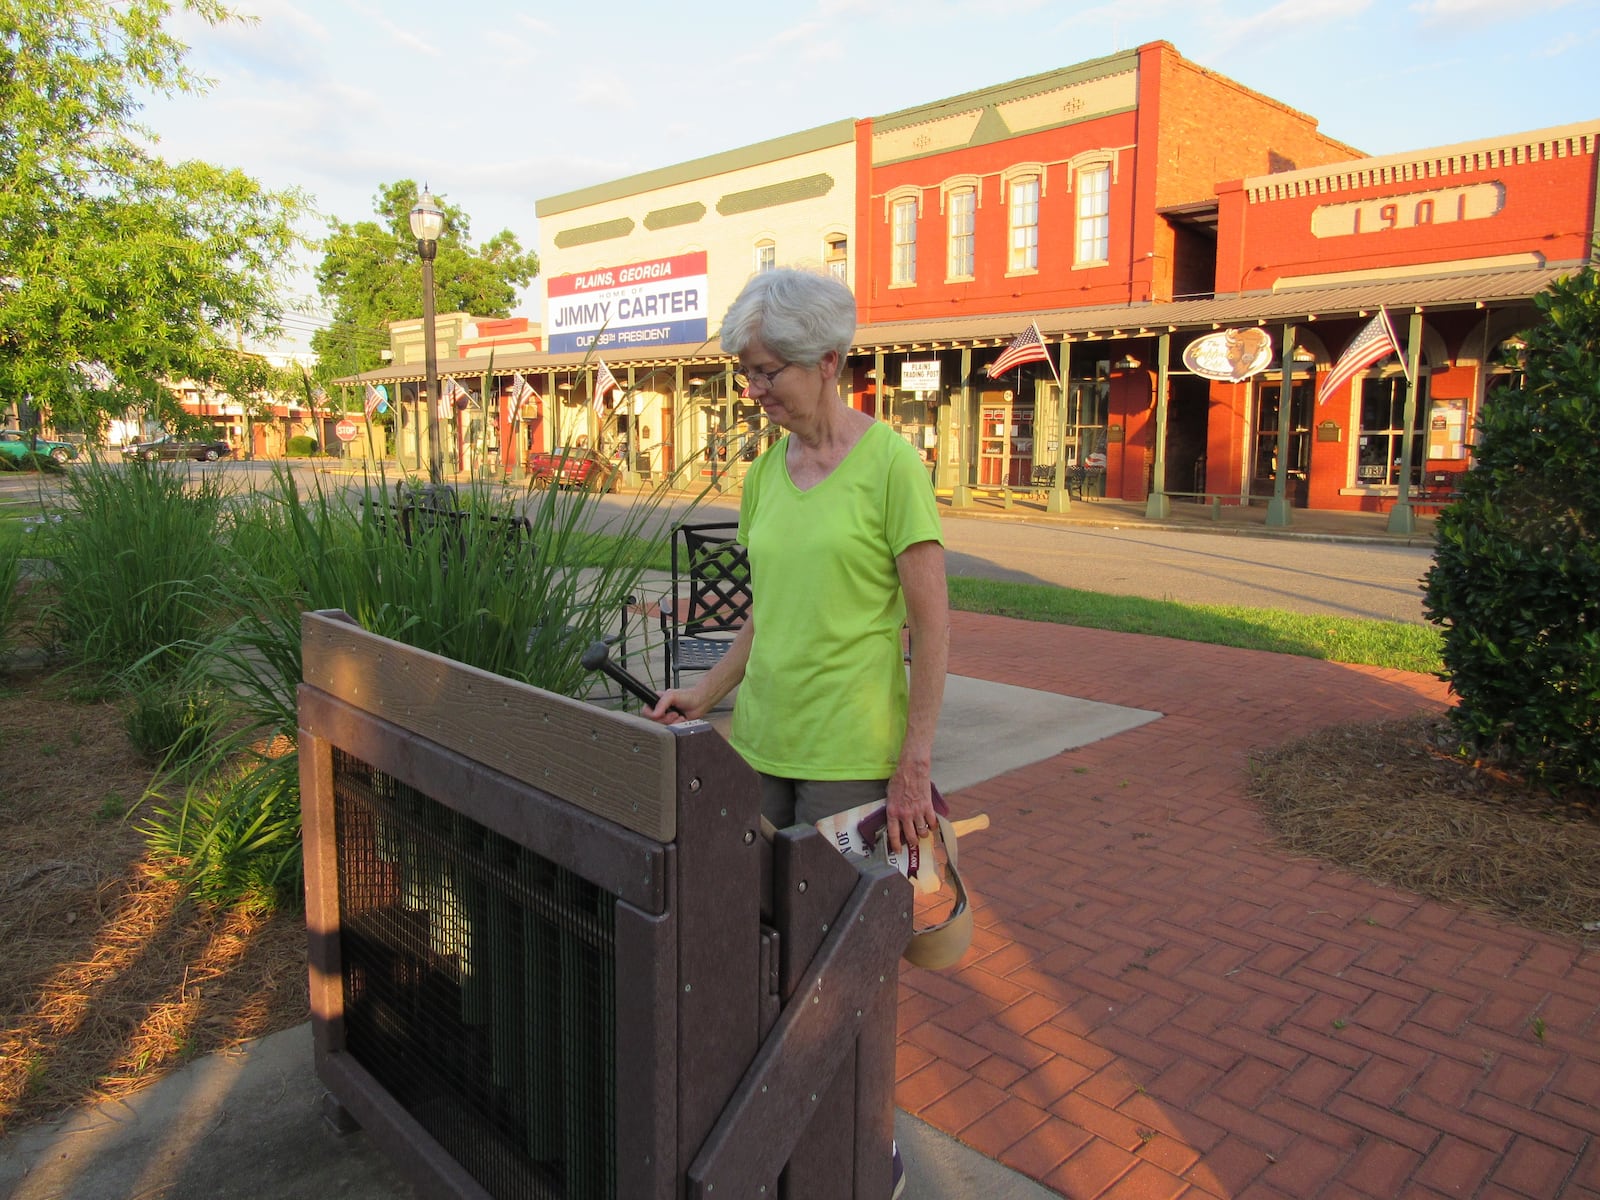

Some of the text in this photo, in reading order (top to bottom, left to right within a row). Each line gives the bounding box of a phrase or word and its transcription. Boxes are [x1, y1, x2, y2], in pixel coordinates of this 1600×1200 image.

[1353, 193, 1466, 234] 1901
[575, 262, 672, 290] PLAINS, GEORGIA
[599, 287, 643, 298] HOME OF
[555, 289, 698, 327] JIMMY CARTER
[618, 327, 671, 343] PRESIDENT
[903, 370, 939, 378] TRADING POST
[337, 426, 356, 435] STOP
[835, 831, 850, 846] OF
